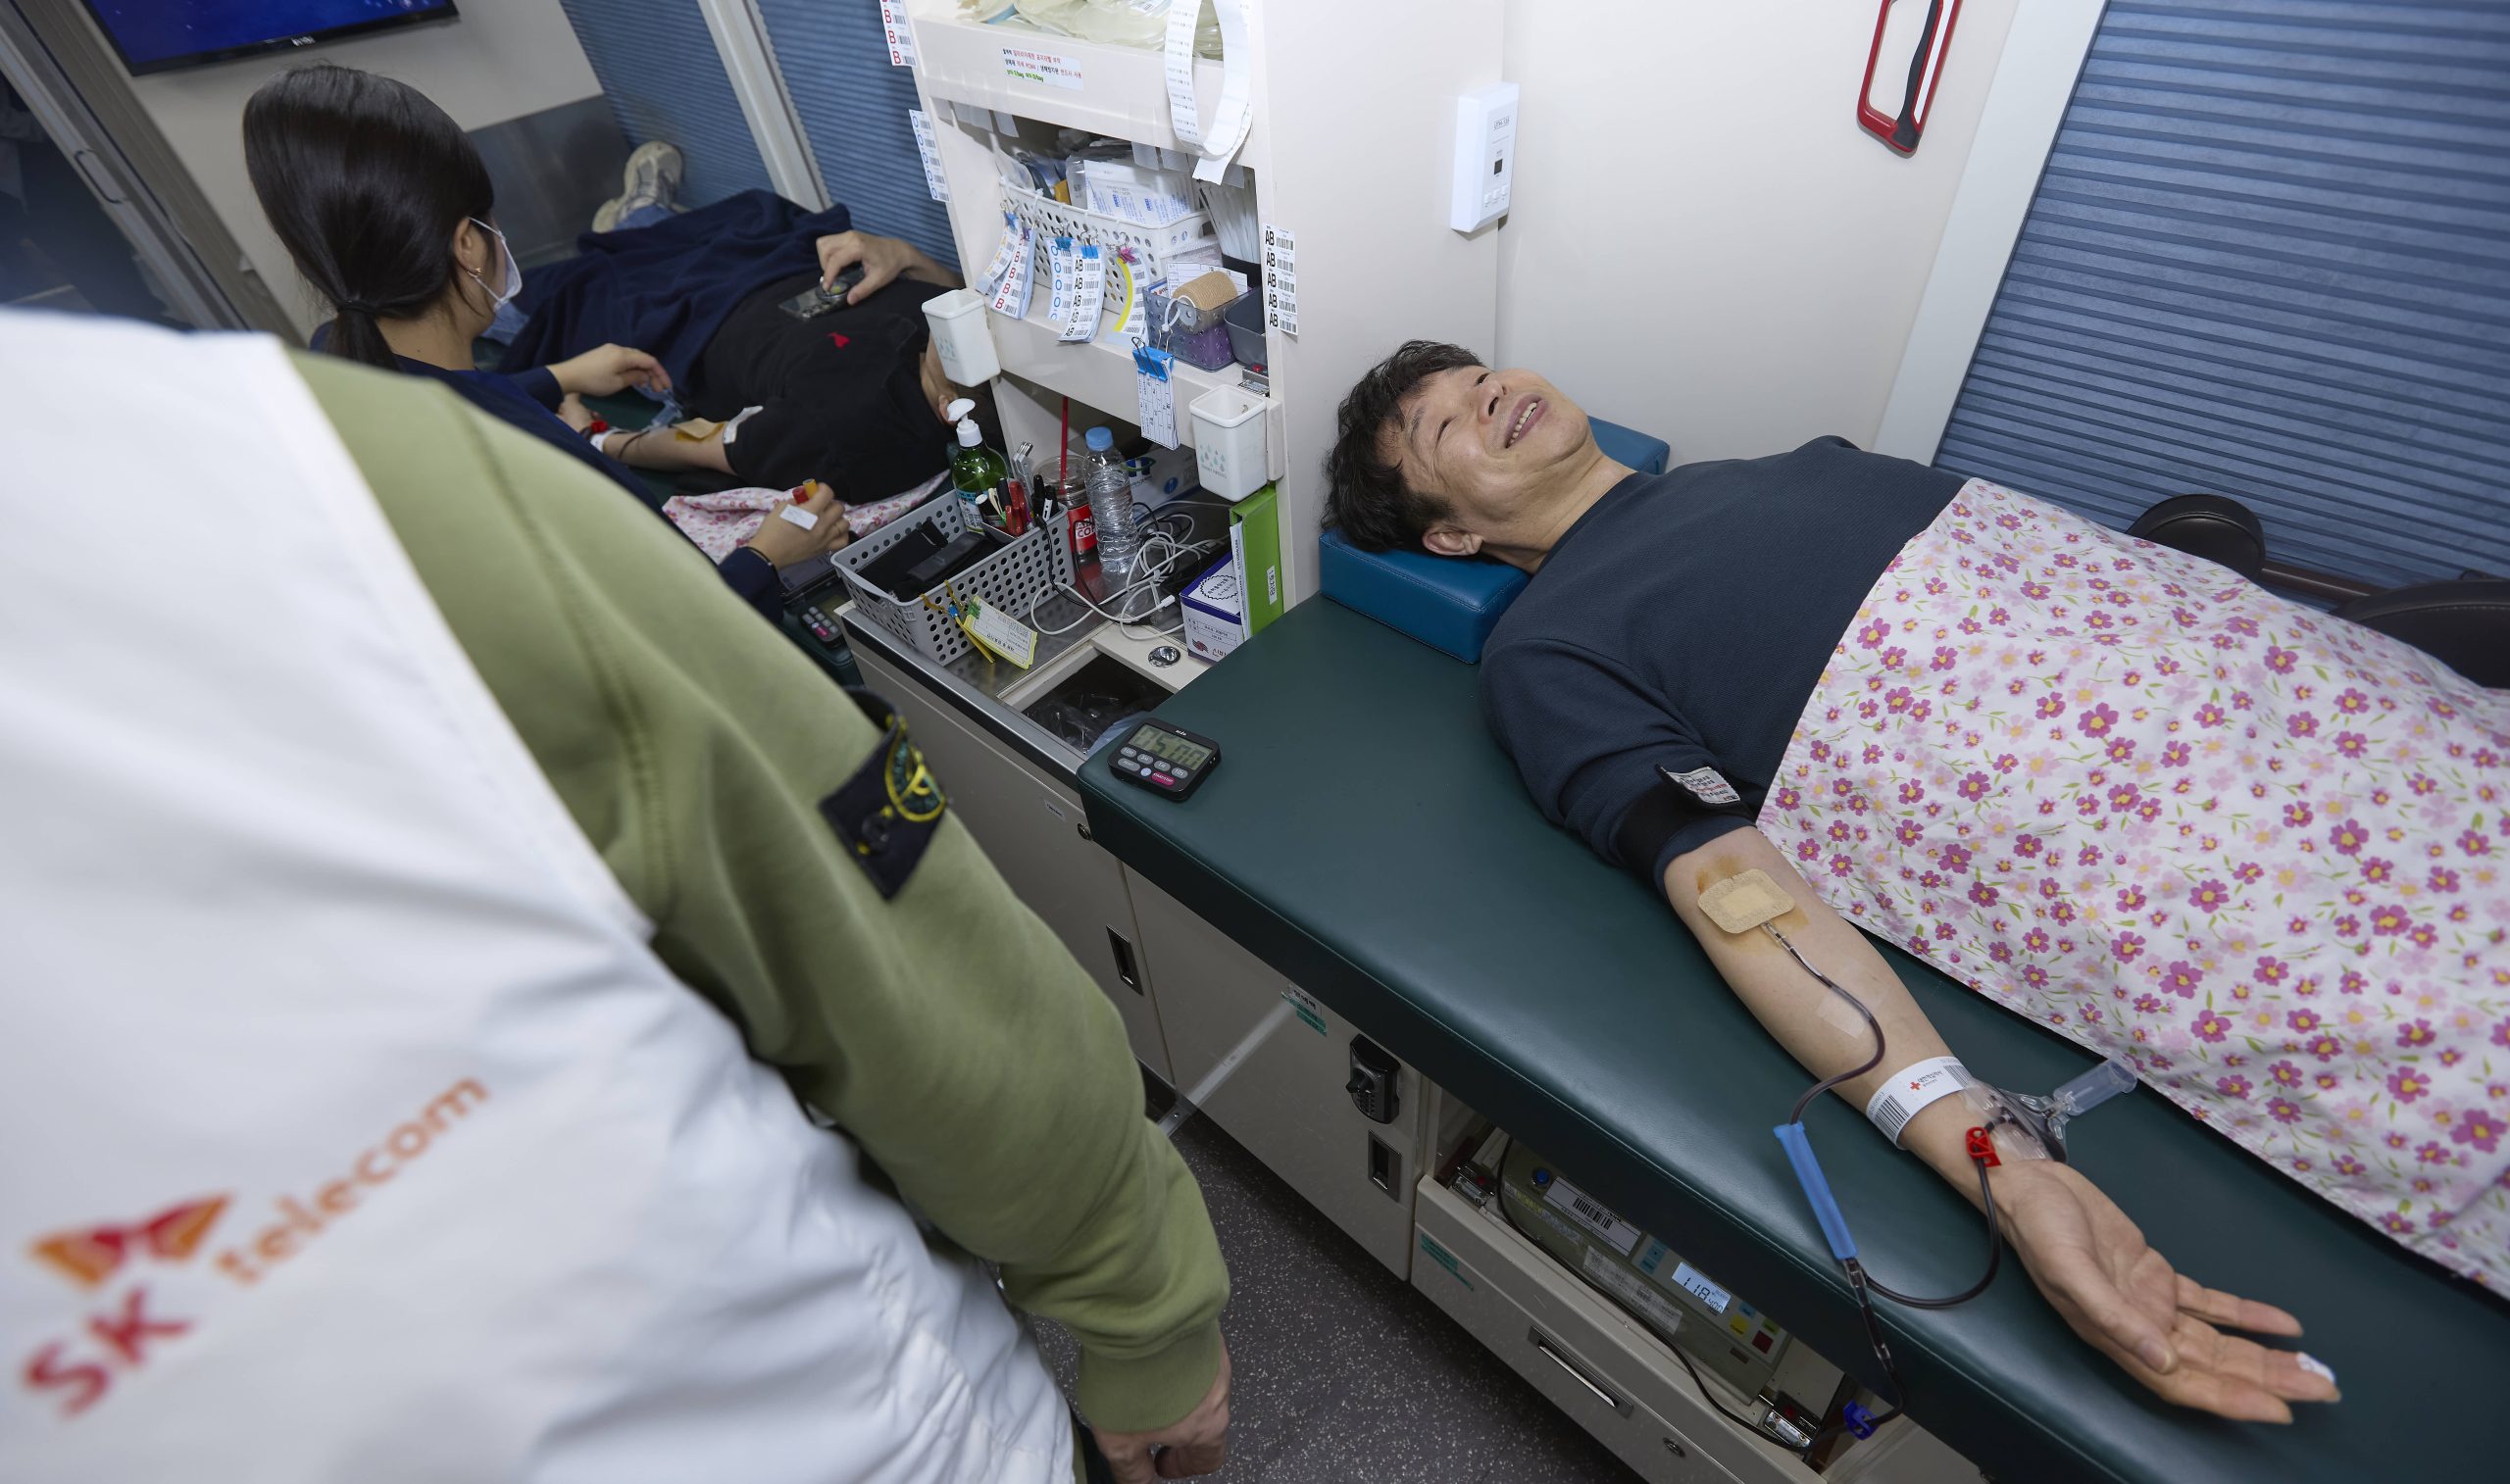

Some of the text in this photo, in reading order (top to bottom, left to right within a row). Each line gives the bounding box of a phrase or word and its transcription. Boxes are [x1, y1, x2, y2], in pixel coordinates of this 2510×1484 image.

[884, 9, 892, 24] B
[888, 30, 896, 44] B
[892, 50, 902, 64] B
[1265, 229, 1275, 246] AB
[1075, 259, 1083, 272] AB
[1266, 251, 1276, 268] AB
[1009, 268, 1016, 279] B
[1267, 272, 1277, 288] AB
[1003, 283, 1011, 294] B
[1074, 277, 1083, 290] AB
[995, 298, 1004, 309] B
[1073, 294, 1081, 308] AB
[1268, 293, 1278, 309] AB
[1269, 313, 1279, 327] AB
[22, 1076, 490, 1421] SK telecom
